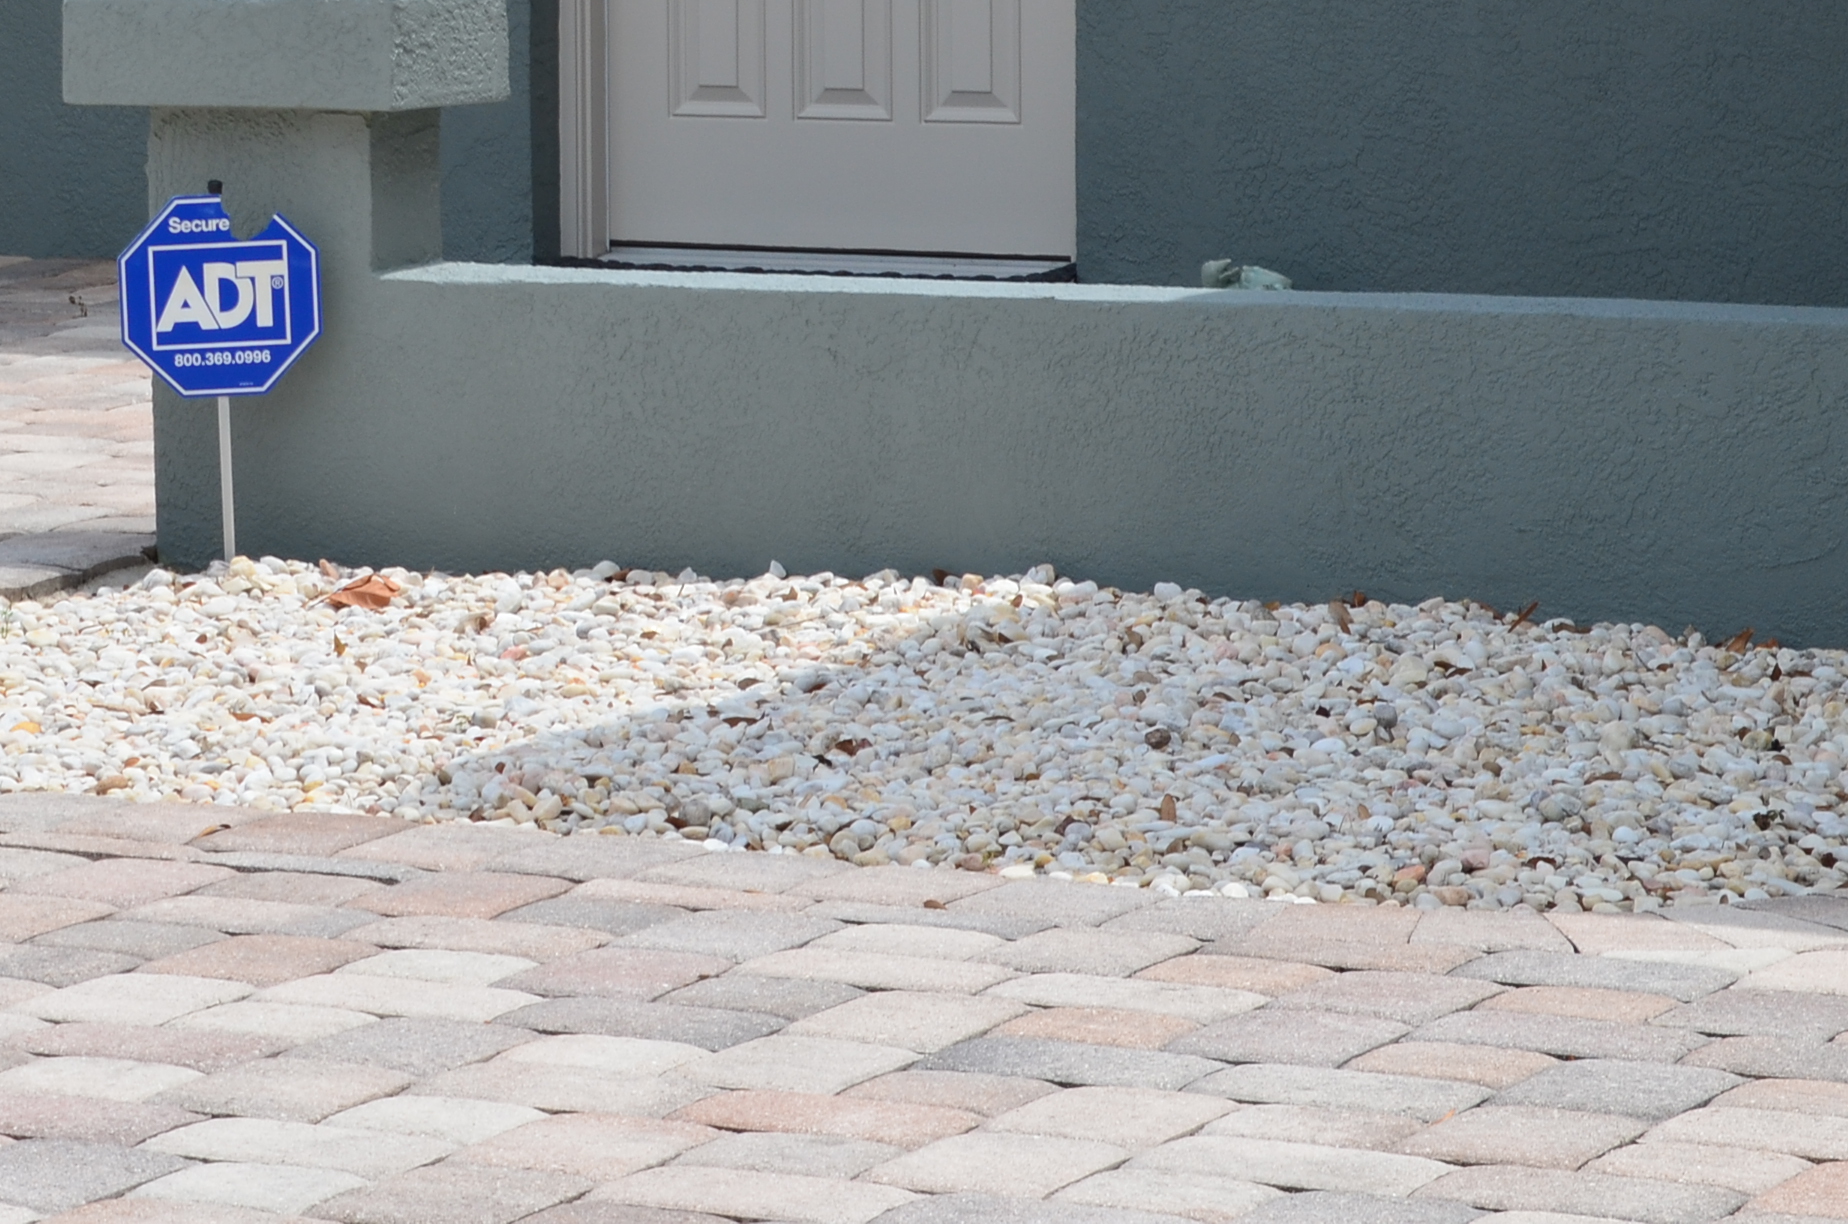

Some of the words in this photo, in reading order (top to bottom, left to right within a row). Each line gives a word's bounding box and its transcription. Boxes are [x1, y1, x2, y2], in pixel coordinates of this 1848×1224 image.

[168, 216, 230, 234] Secure
[155, 260, 285, 332] ADT
[174, 349, 271, 367] 800.369.0996
